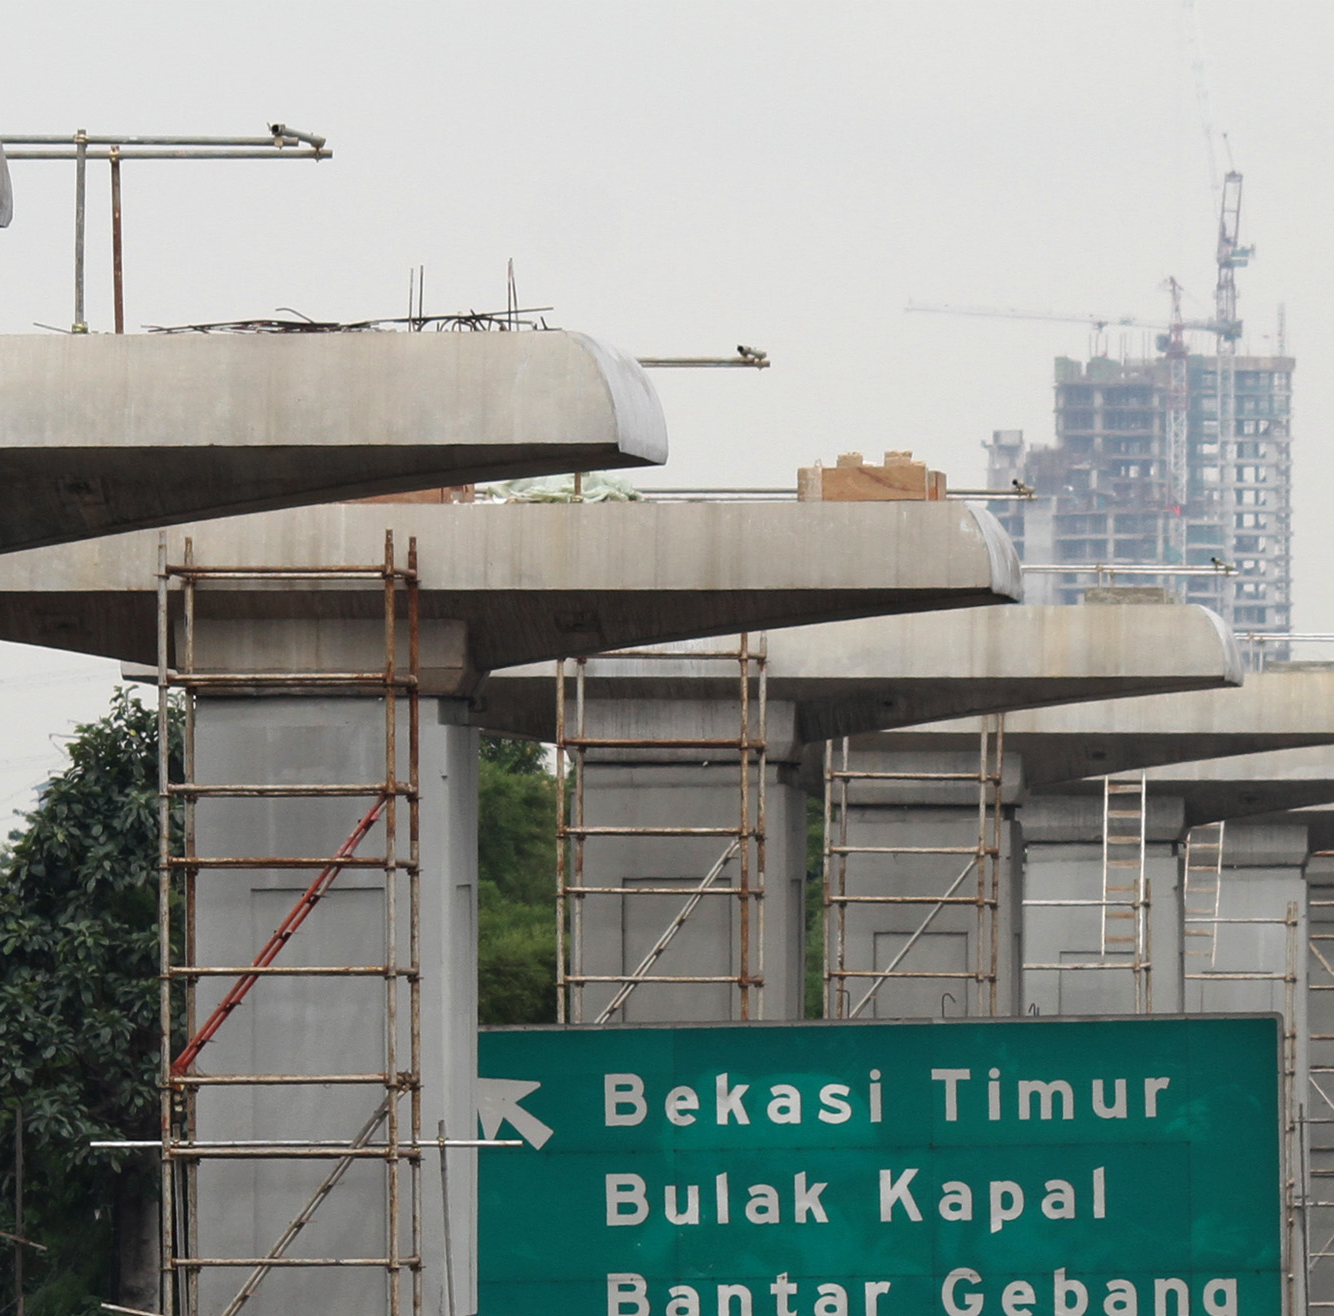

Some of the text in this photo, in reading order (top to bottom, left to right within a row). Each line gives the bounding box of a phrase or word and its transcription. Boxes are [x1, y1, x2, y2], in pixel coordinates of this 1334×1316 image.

[602, 1066, 1172, 1129] Bekasi Timur
[604, 1166, 1108, 1234] Bulak Kapal
